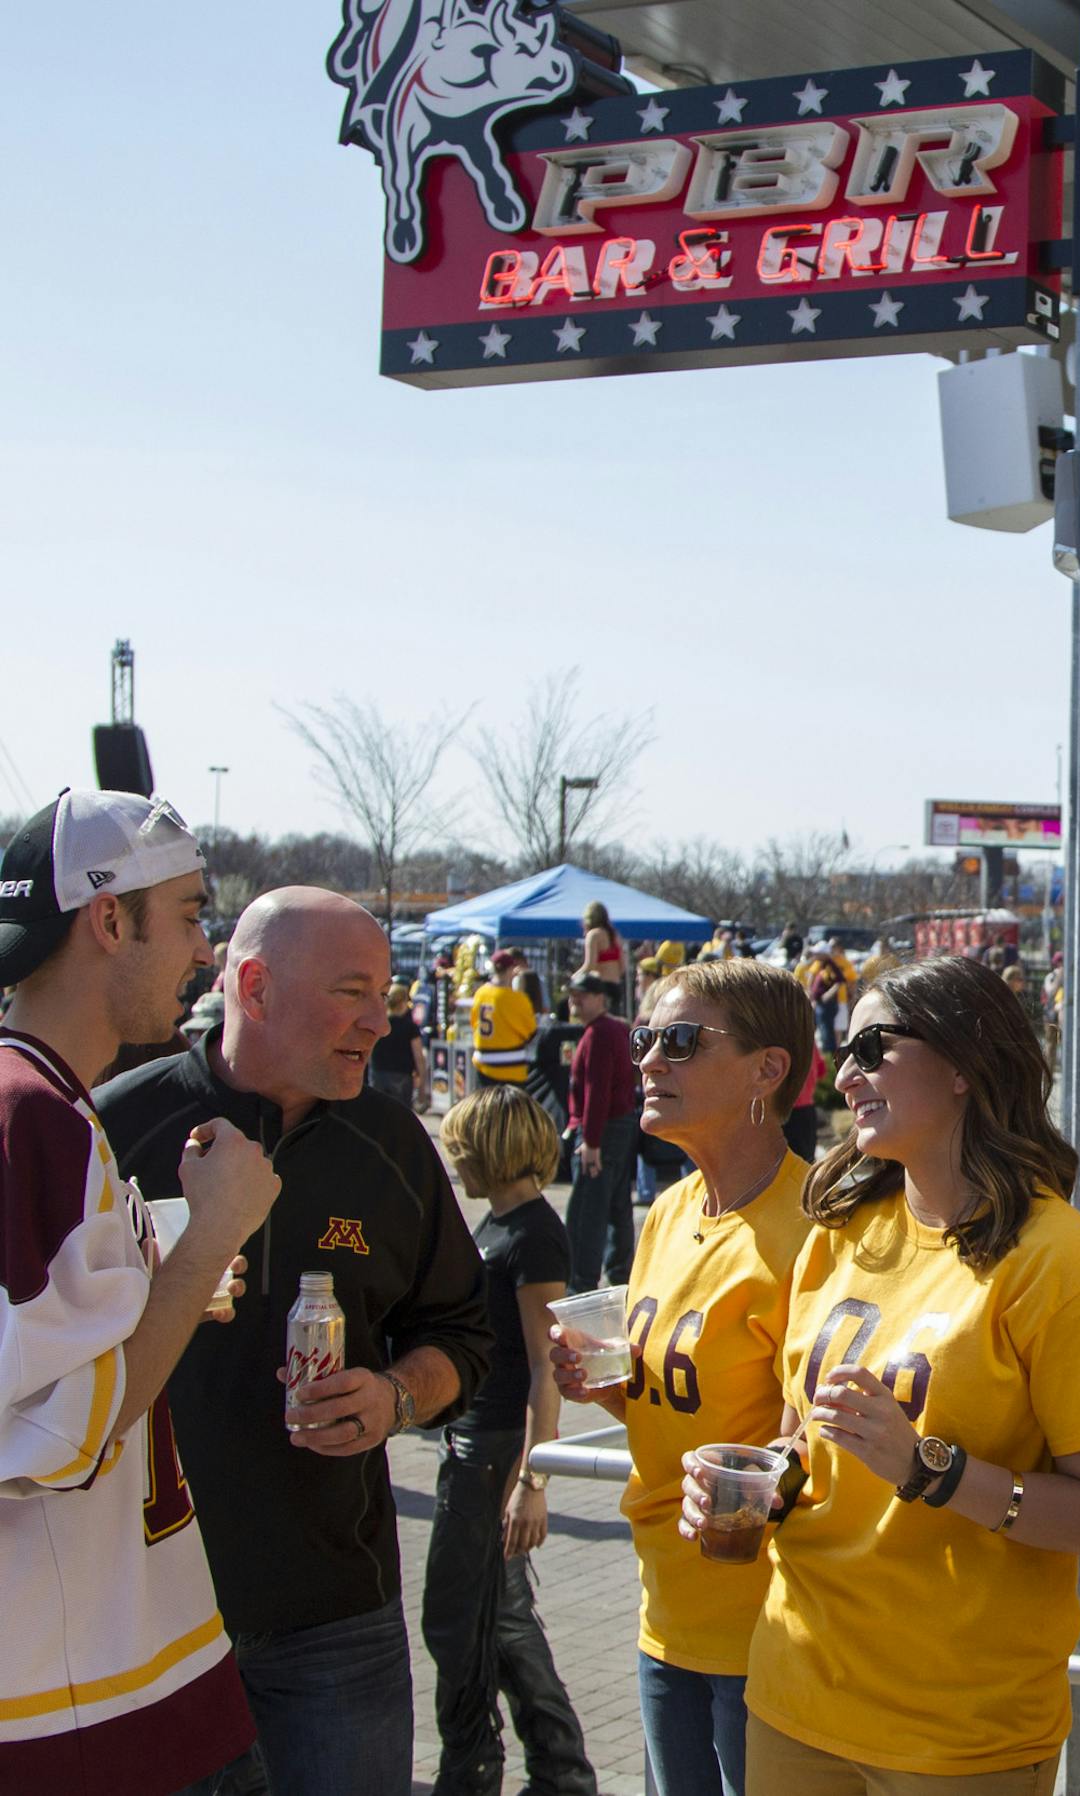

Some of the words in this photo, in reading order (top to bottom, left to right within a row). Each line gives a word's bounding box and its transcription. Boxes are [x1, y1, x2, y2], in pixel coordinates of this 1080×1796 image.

[531, 103, 1018, 236] PBR
[479, 237, 656, 310] BAR
[668, 228, 733, 291] &
[756, 205, 1018, 284] GRILL
[479, 1004, 494, 1038] 5
[318, 1216, 369, 1255] M
